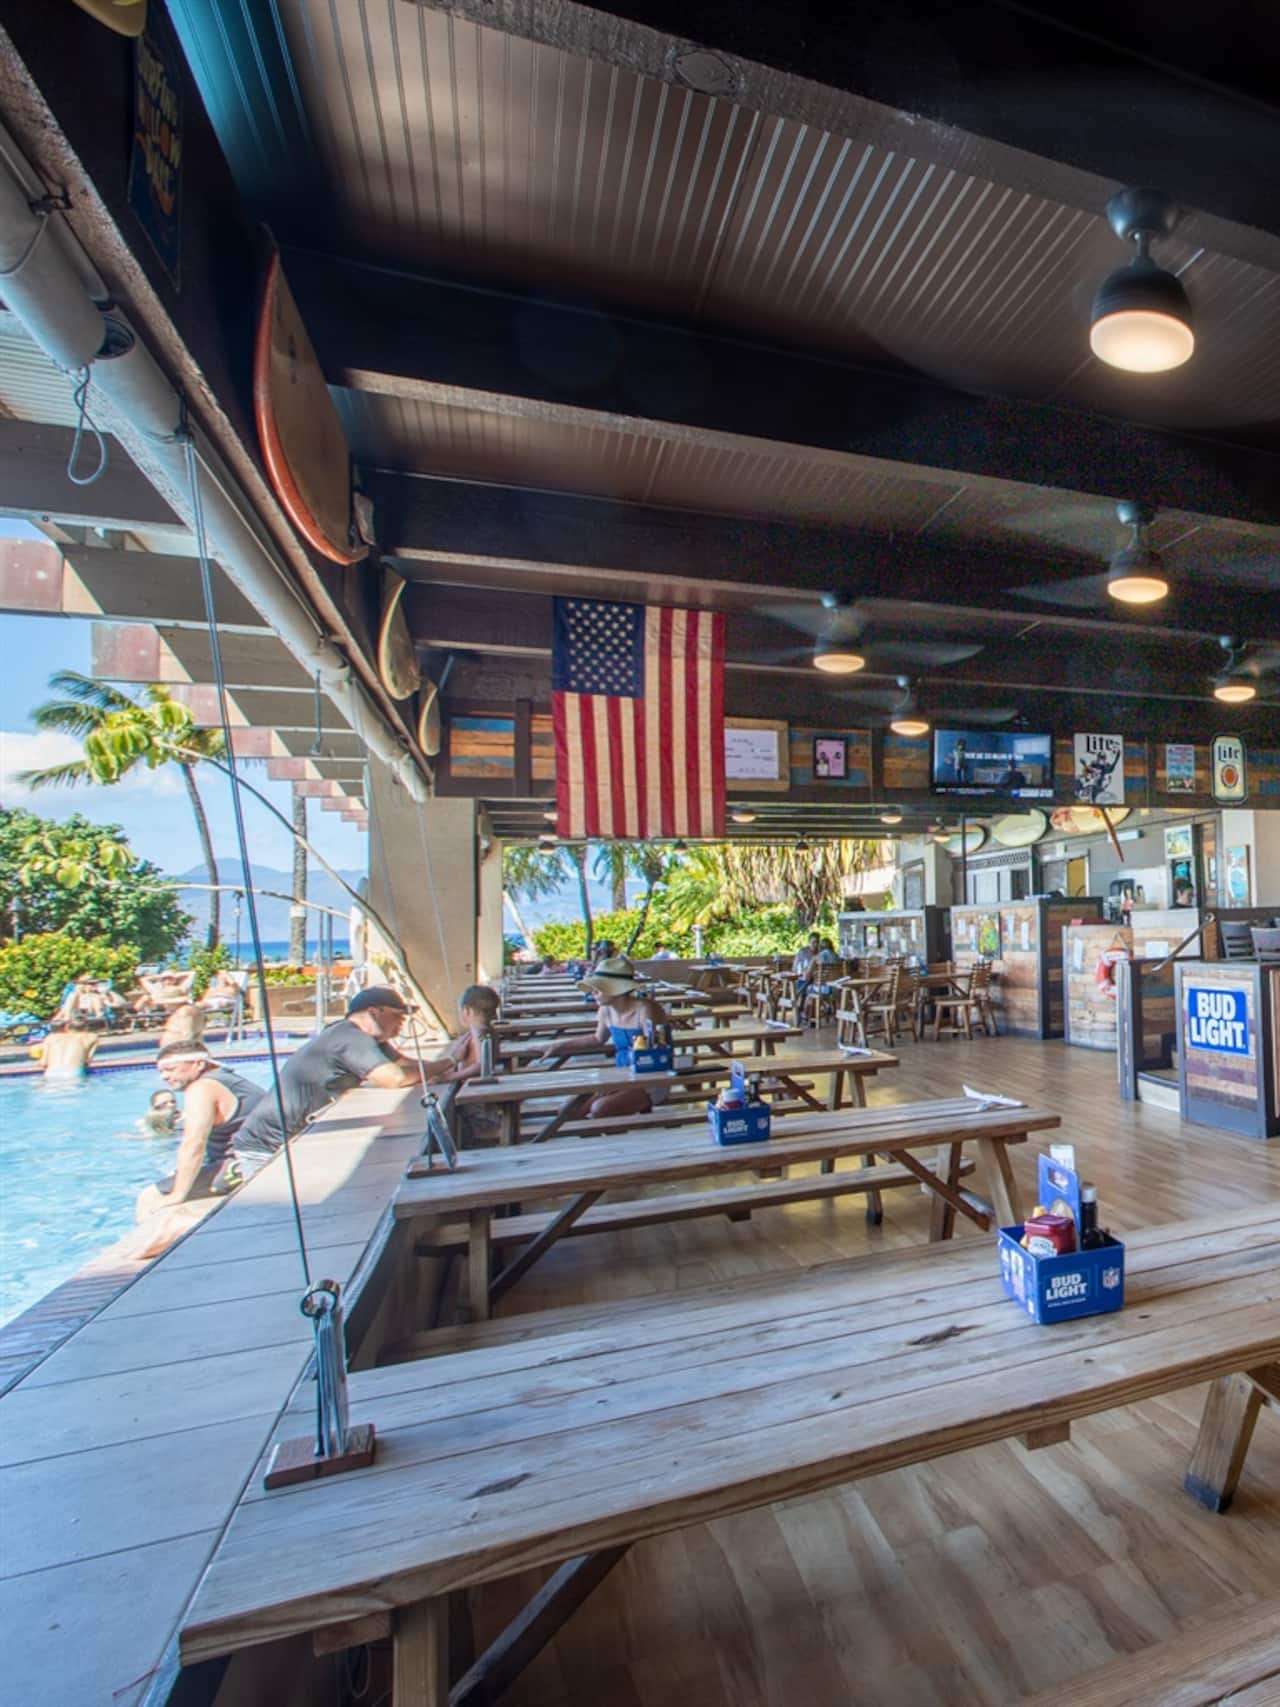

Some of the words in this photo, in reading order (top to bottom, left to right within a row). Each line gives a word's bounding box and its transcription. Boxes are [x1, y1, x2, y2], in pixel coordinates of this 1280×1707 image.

[1086, 735, 1114, 754] Lite
[1217, 745, 1240, 763] Lite
[1196, 991, 1236, 1020] BUD
[1190, 1017, 1245, 1048] LIGHT
[1051, 1273, 1082, 1288] BUD
[1046, 1282, 1088, 1300] LIGHT
